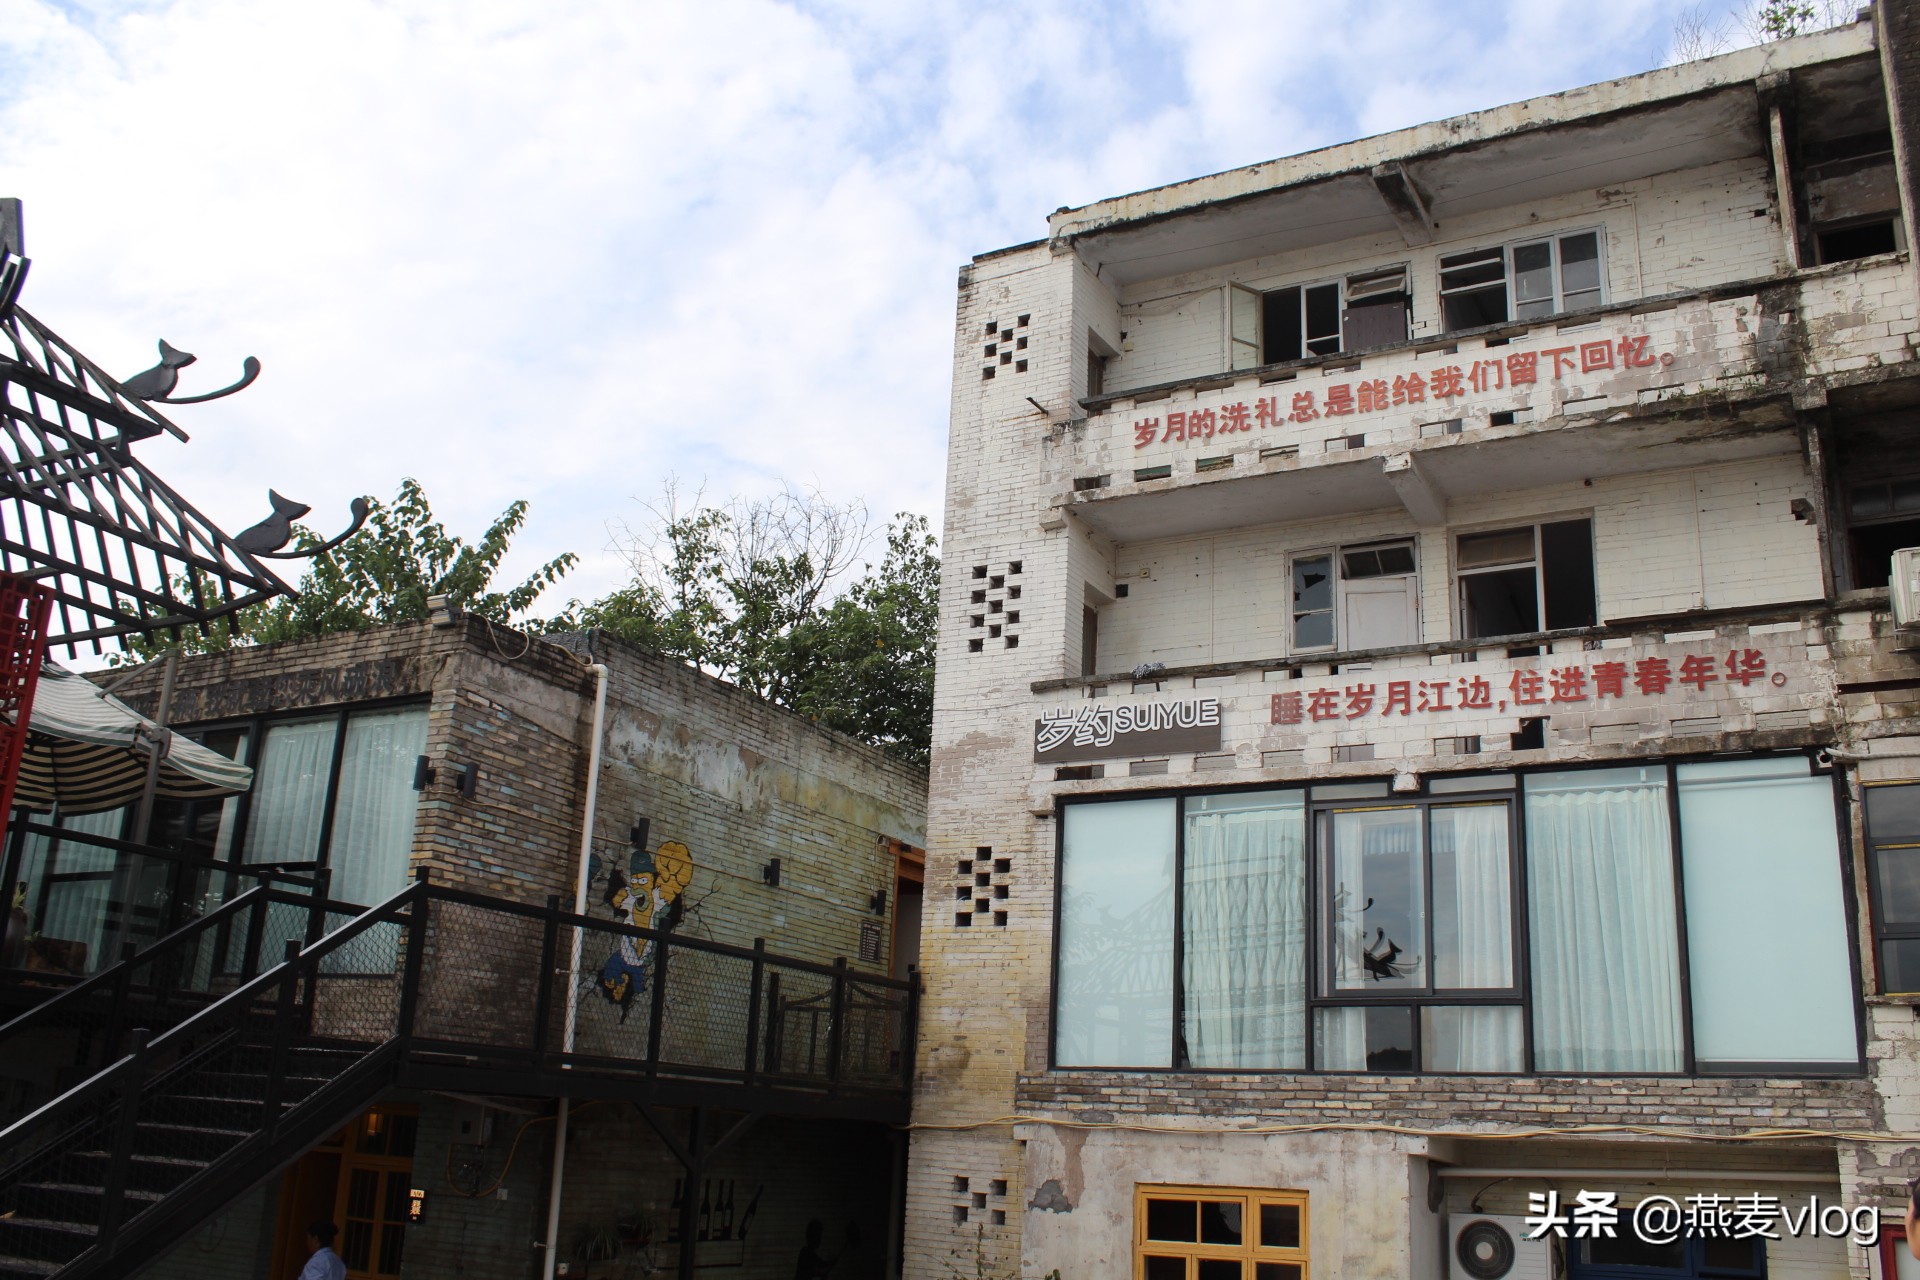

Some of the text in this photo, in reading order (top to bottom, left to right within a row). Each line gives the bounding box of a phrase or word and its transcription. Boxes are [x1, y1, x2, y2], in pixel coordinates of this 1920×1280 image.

[1134, 335, 1674, 450] 岁月的洗礼总是能给我们留下回忆。
[1114, 697, 1220, 734] SUIYUE
